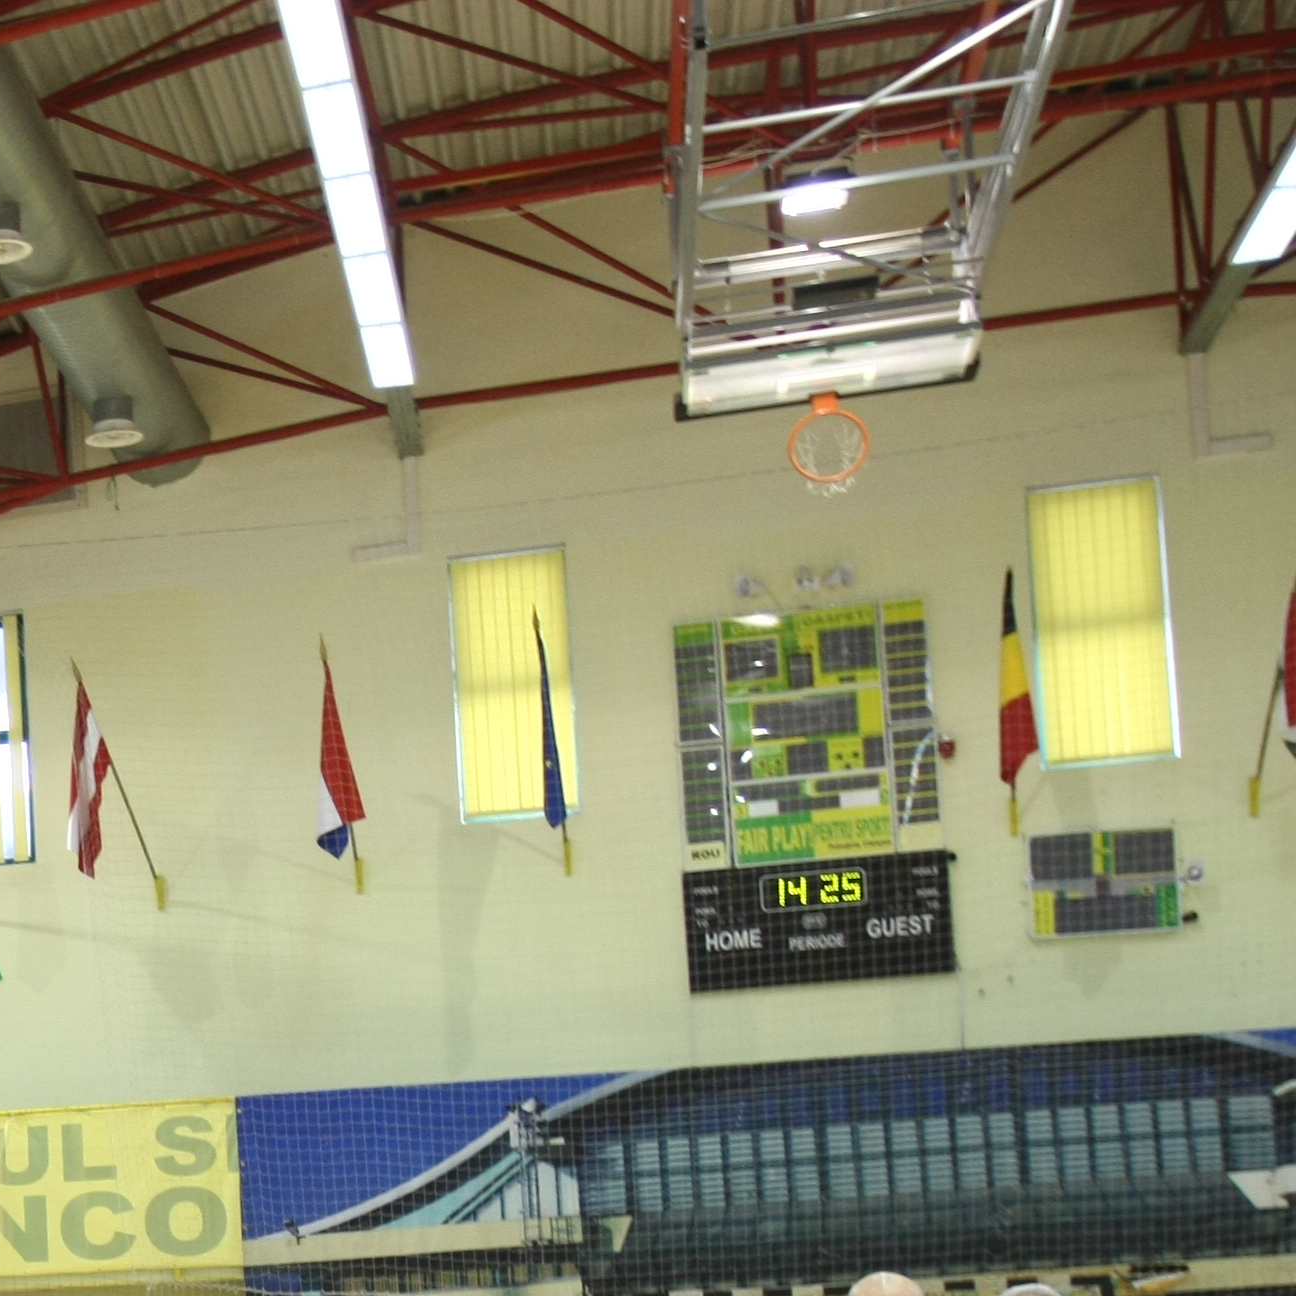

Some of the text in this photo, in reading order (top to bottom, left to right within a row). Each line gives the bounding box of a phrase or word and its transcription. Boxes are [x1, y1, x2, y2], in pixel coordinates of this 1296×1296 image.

[777, 871, 862, 907] 14 25
[865, 912, 935, 939] GUEST
[705, 928, 763, 952] HOME
